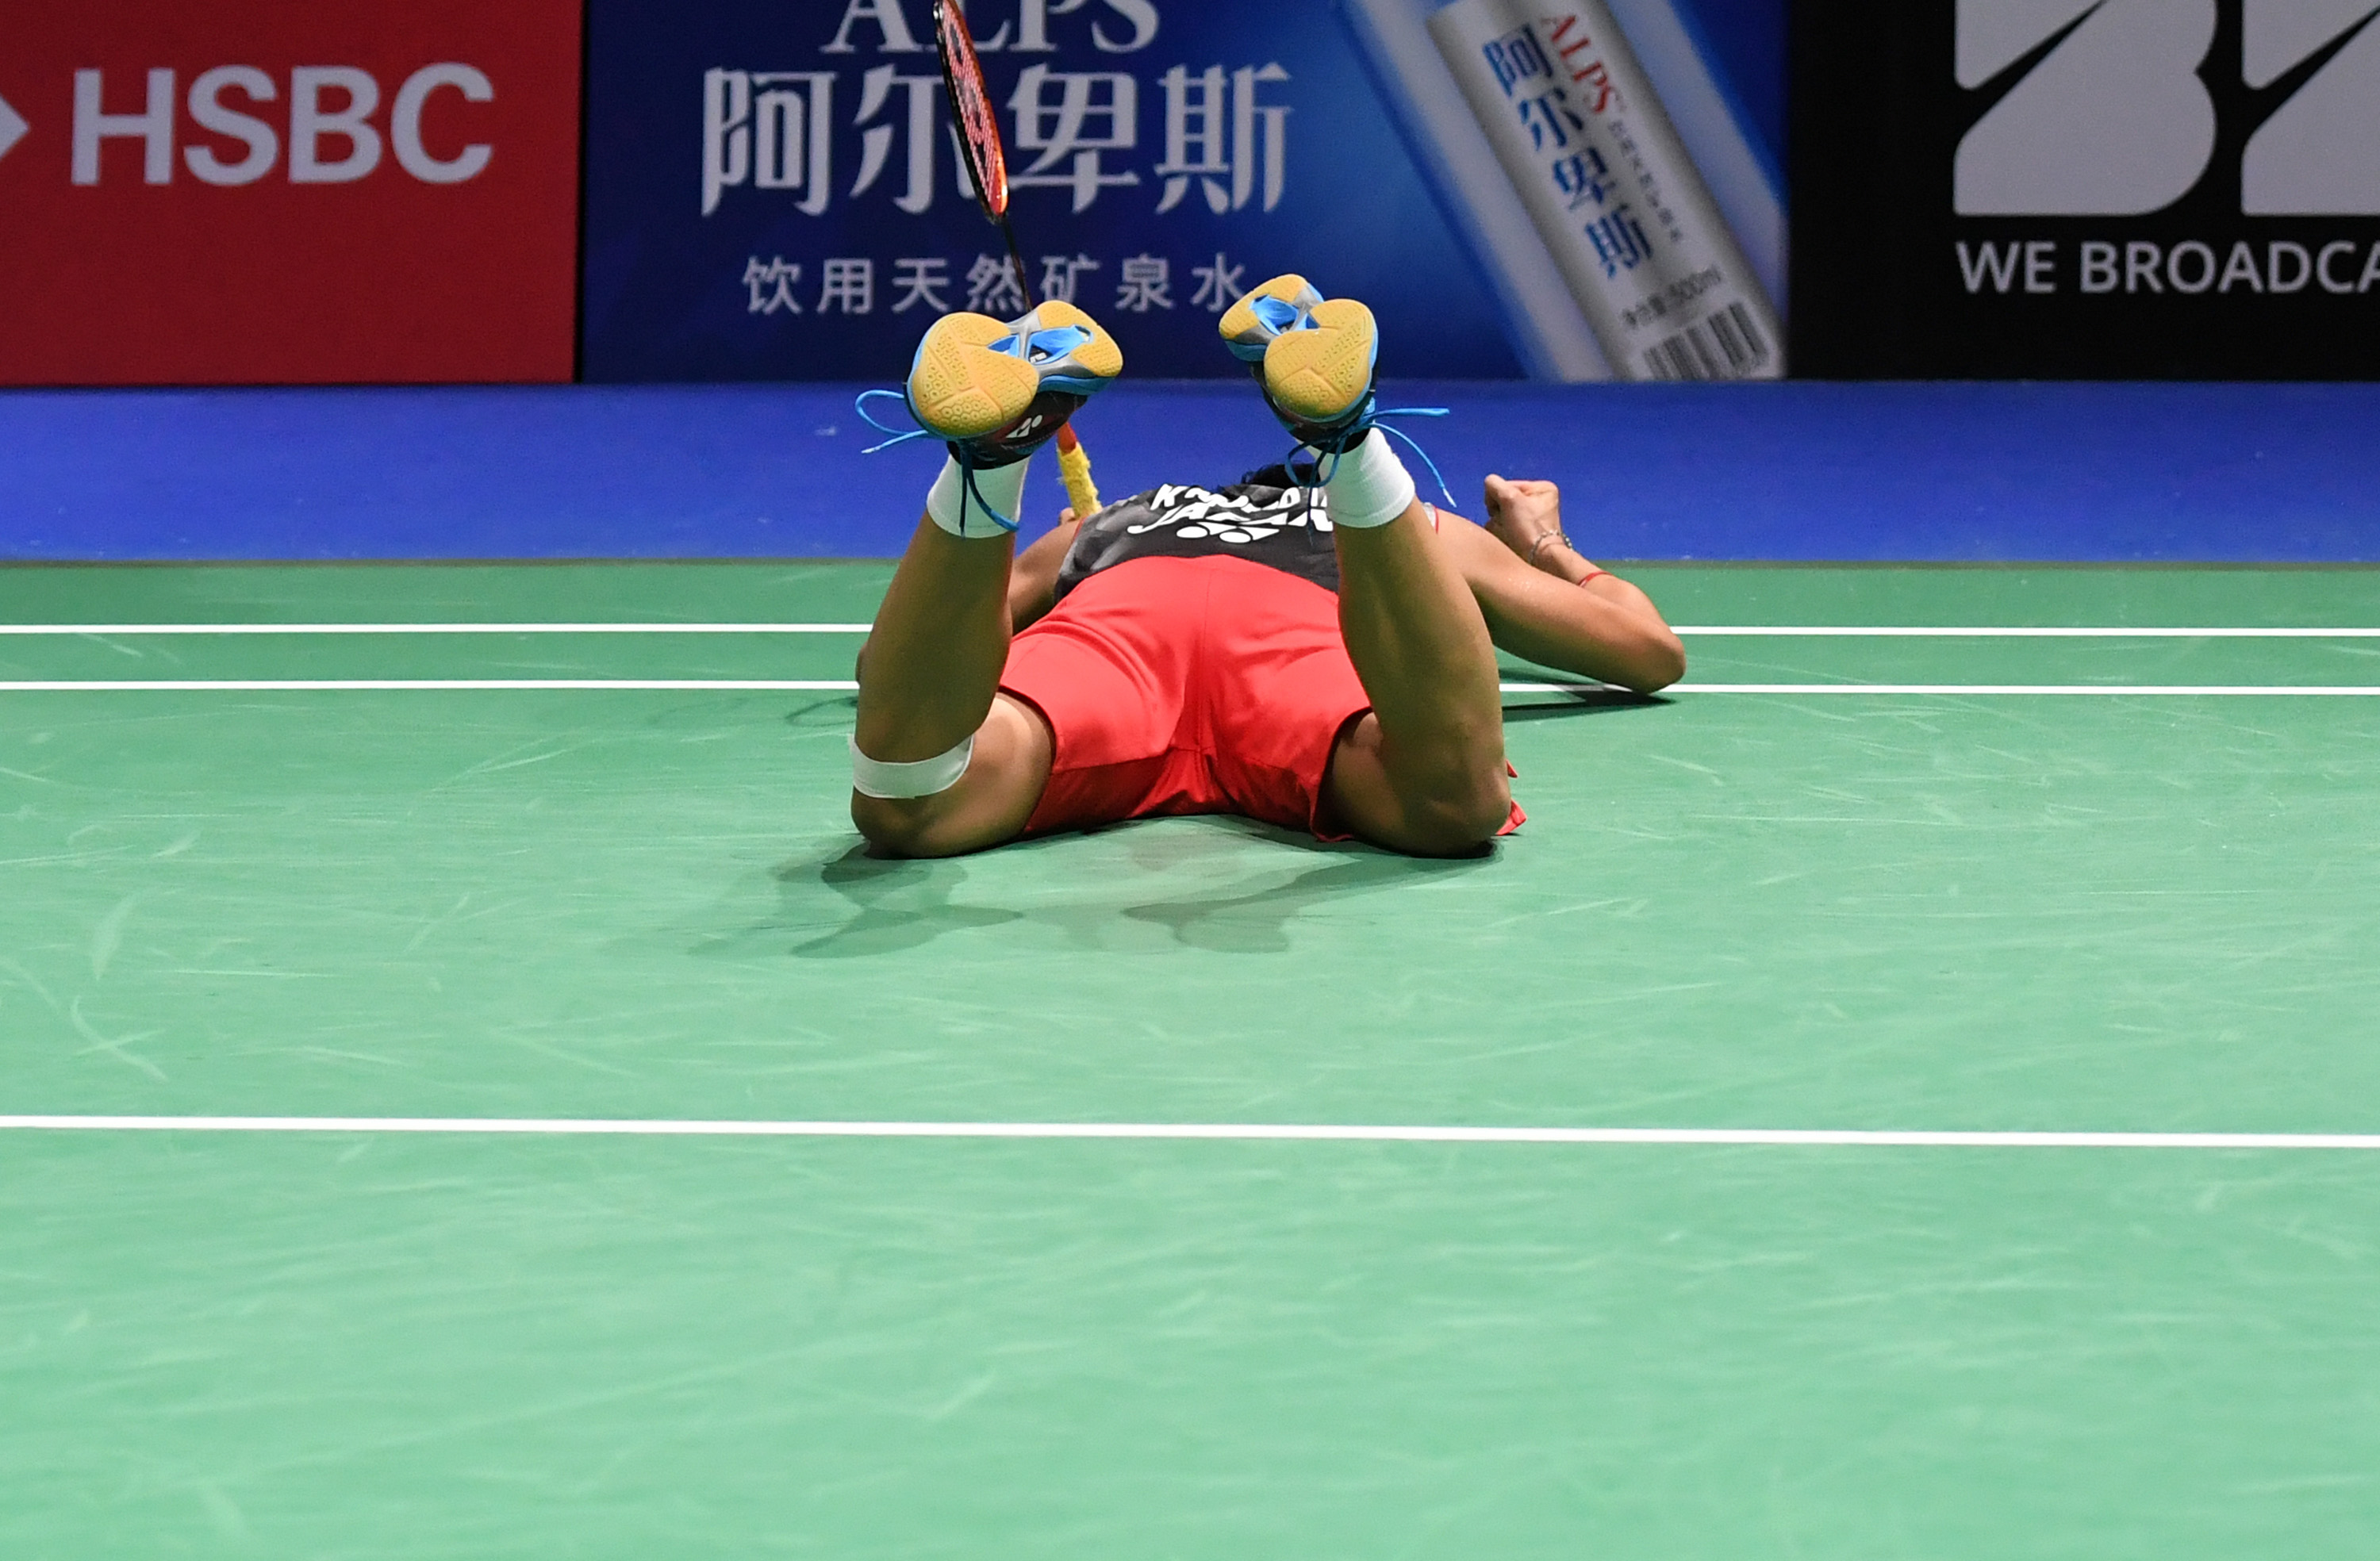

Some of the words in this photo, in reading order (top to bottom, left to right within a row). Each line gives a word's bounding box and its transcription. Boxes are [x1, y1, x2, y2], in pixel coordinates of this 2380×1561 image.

[71, 62, 494, 186] HSBC
[701, 63, 1294, 217] 阿尔卑斯
[1481, 22, 1654, 278] 阿尔卑斯
[742, 252, 1246, 314] 饮用天然矿泉水
[1955, 240, 2057, 293] WE
